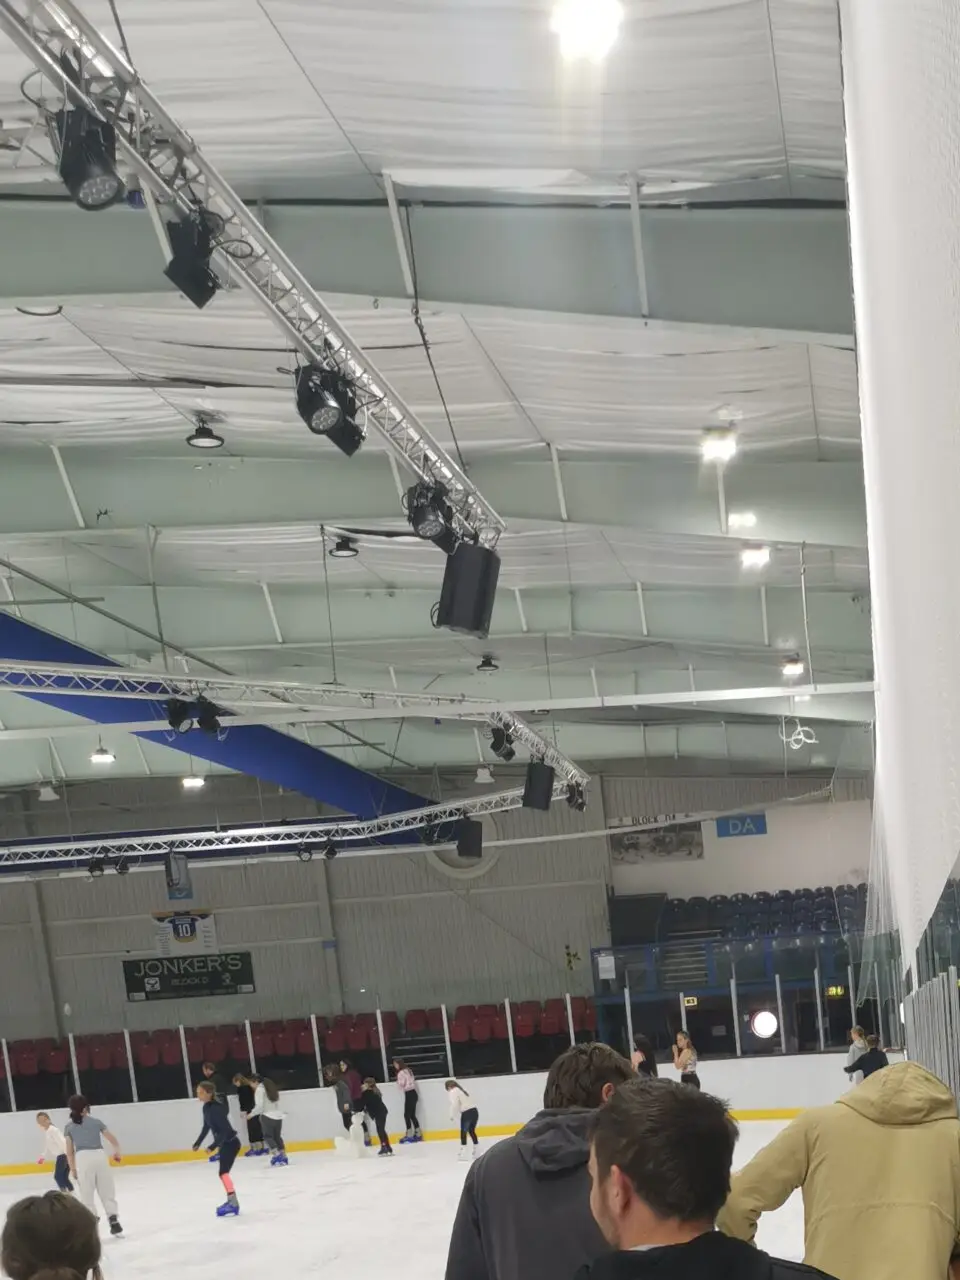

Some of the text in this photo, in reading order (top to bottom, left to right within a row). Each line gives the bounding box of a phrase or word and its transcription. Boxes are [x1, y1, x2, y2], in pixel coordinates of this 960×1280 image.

[729, 816, 757, 835] DA
[178, 923, 191, 938] 10
[134, 954, 242, 977] JONKER'S
